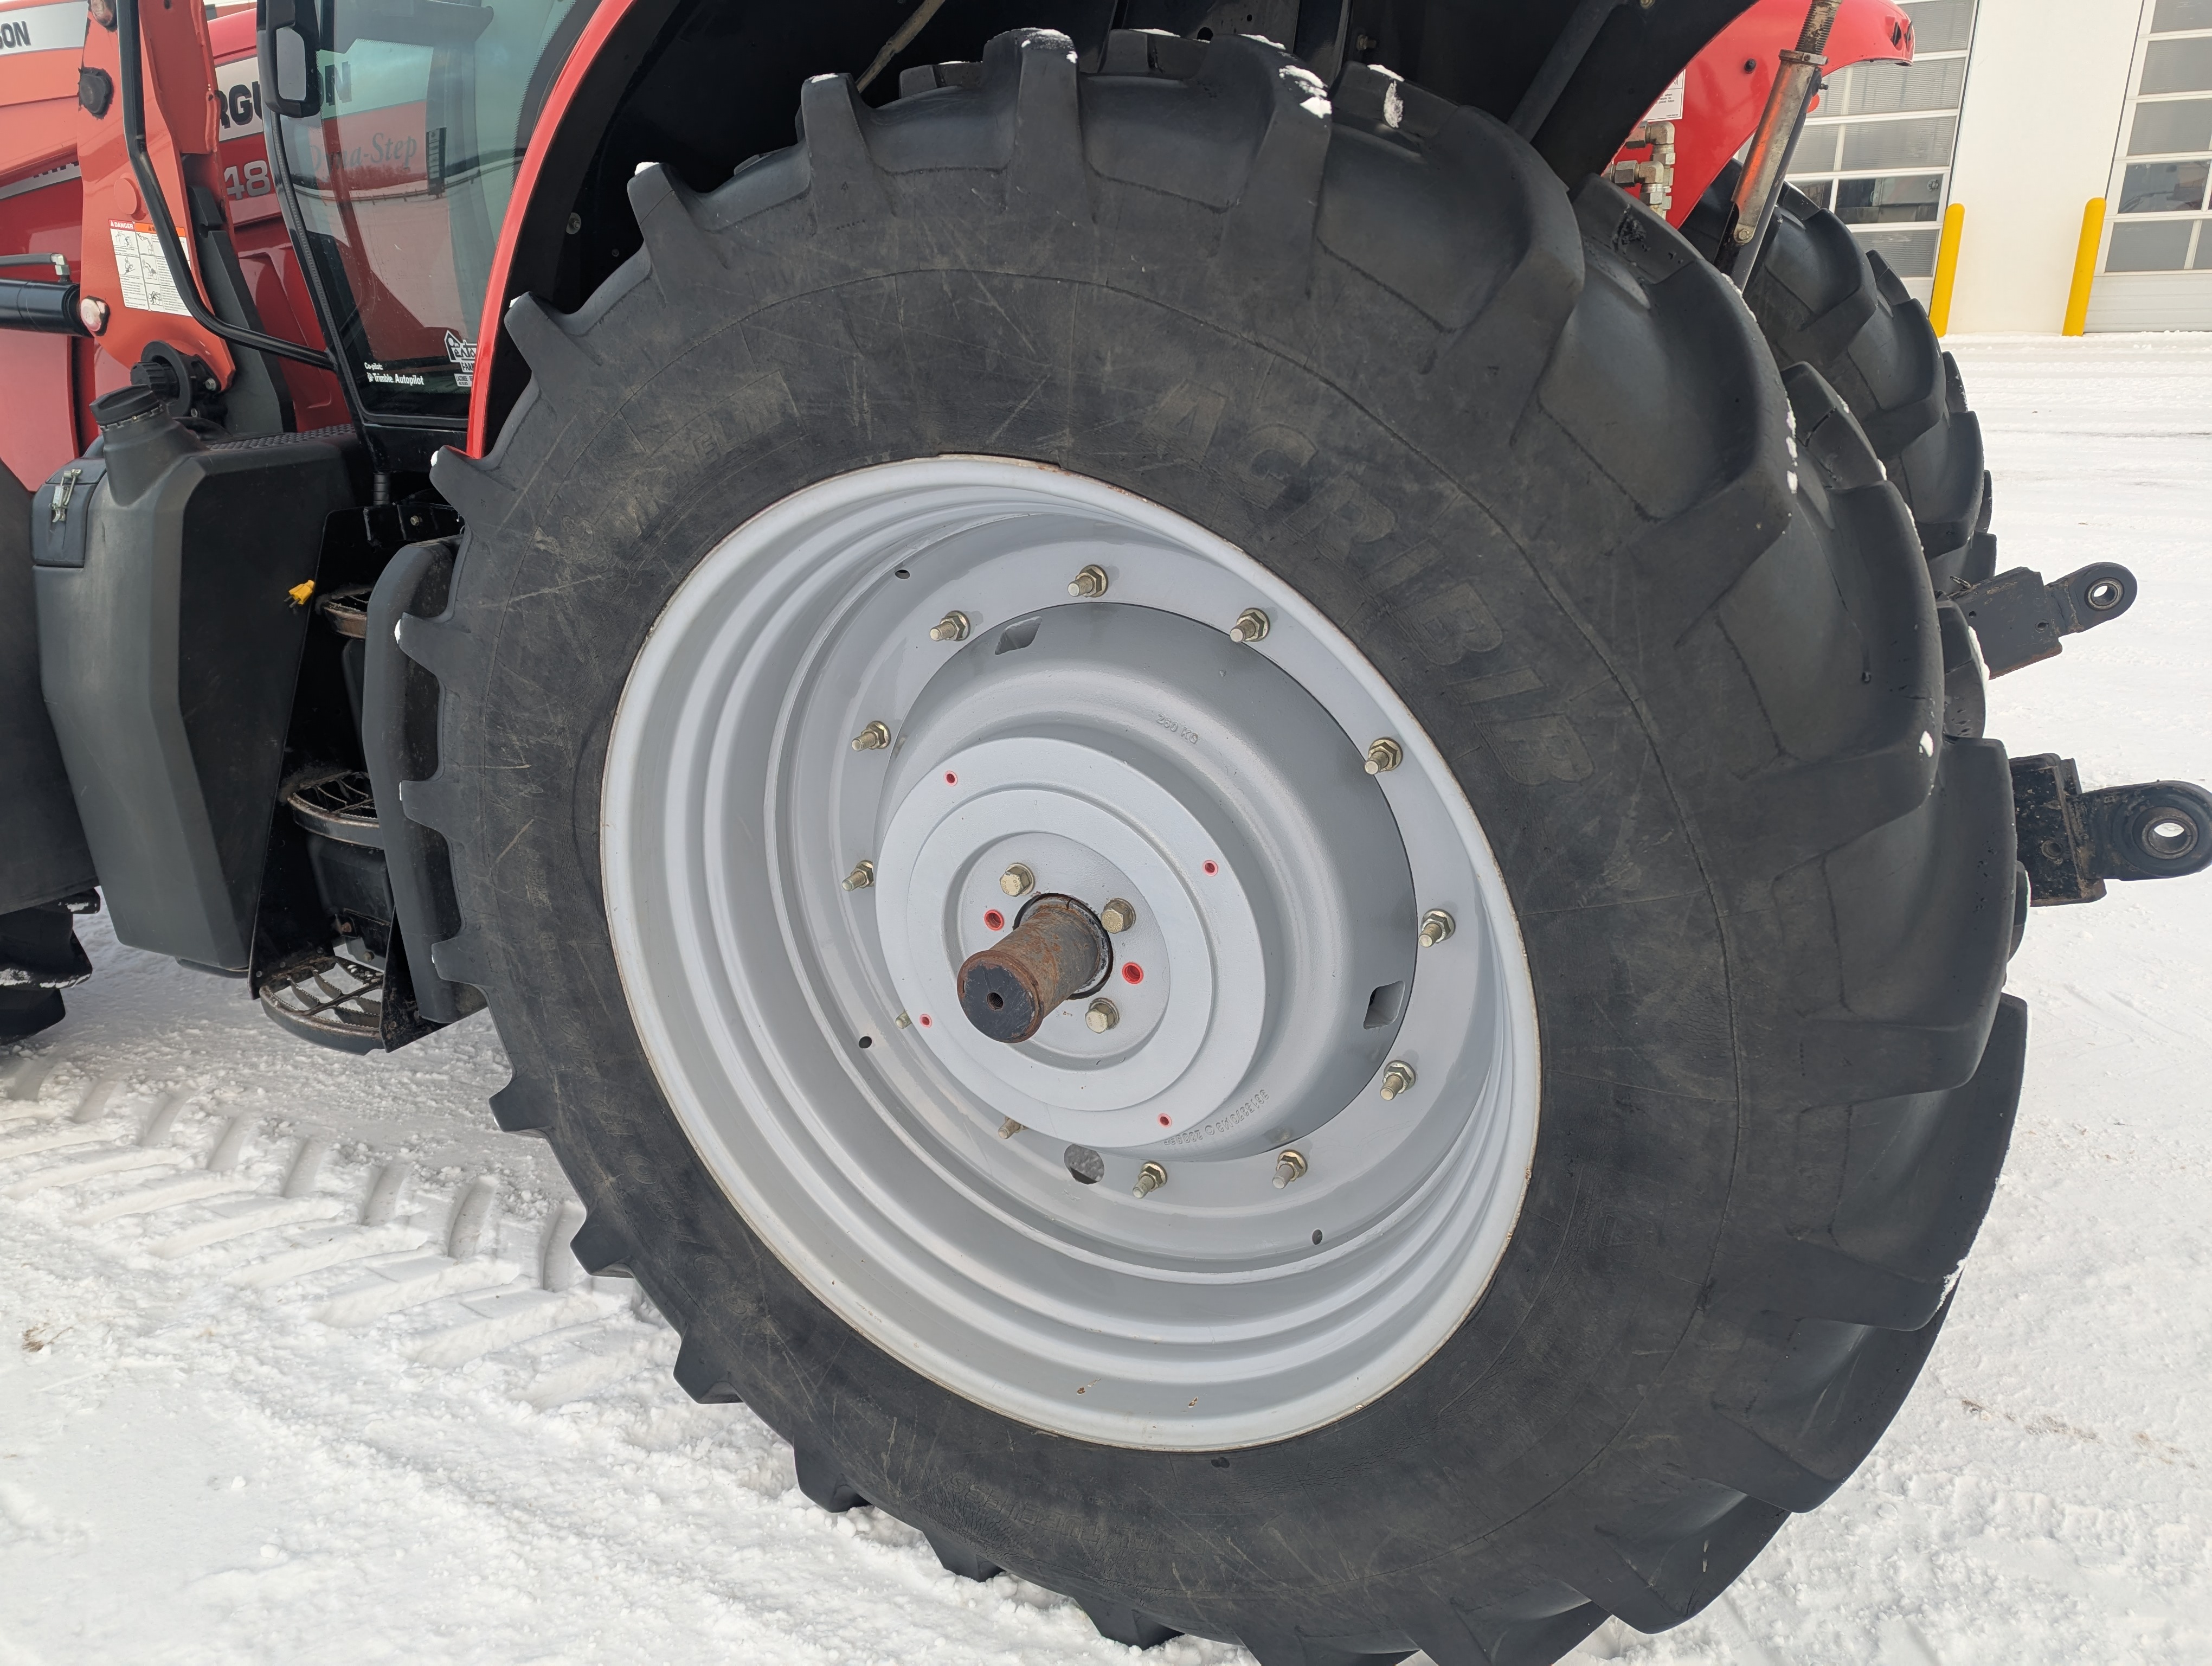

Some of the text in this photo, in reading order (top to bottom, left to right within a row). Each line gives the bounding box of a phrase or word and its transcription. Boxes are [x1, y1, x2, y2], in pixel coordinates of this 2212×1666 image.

[114, 221, 134, 229] DANGER
[395, 373, 425, 386] Autopilot
[1156, 713, 1179, 732] 260
